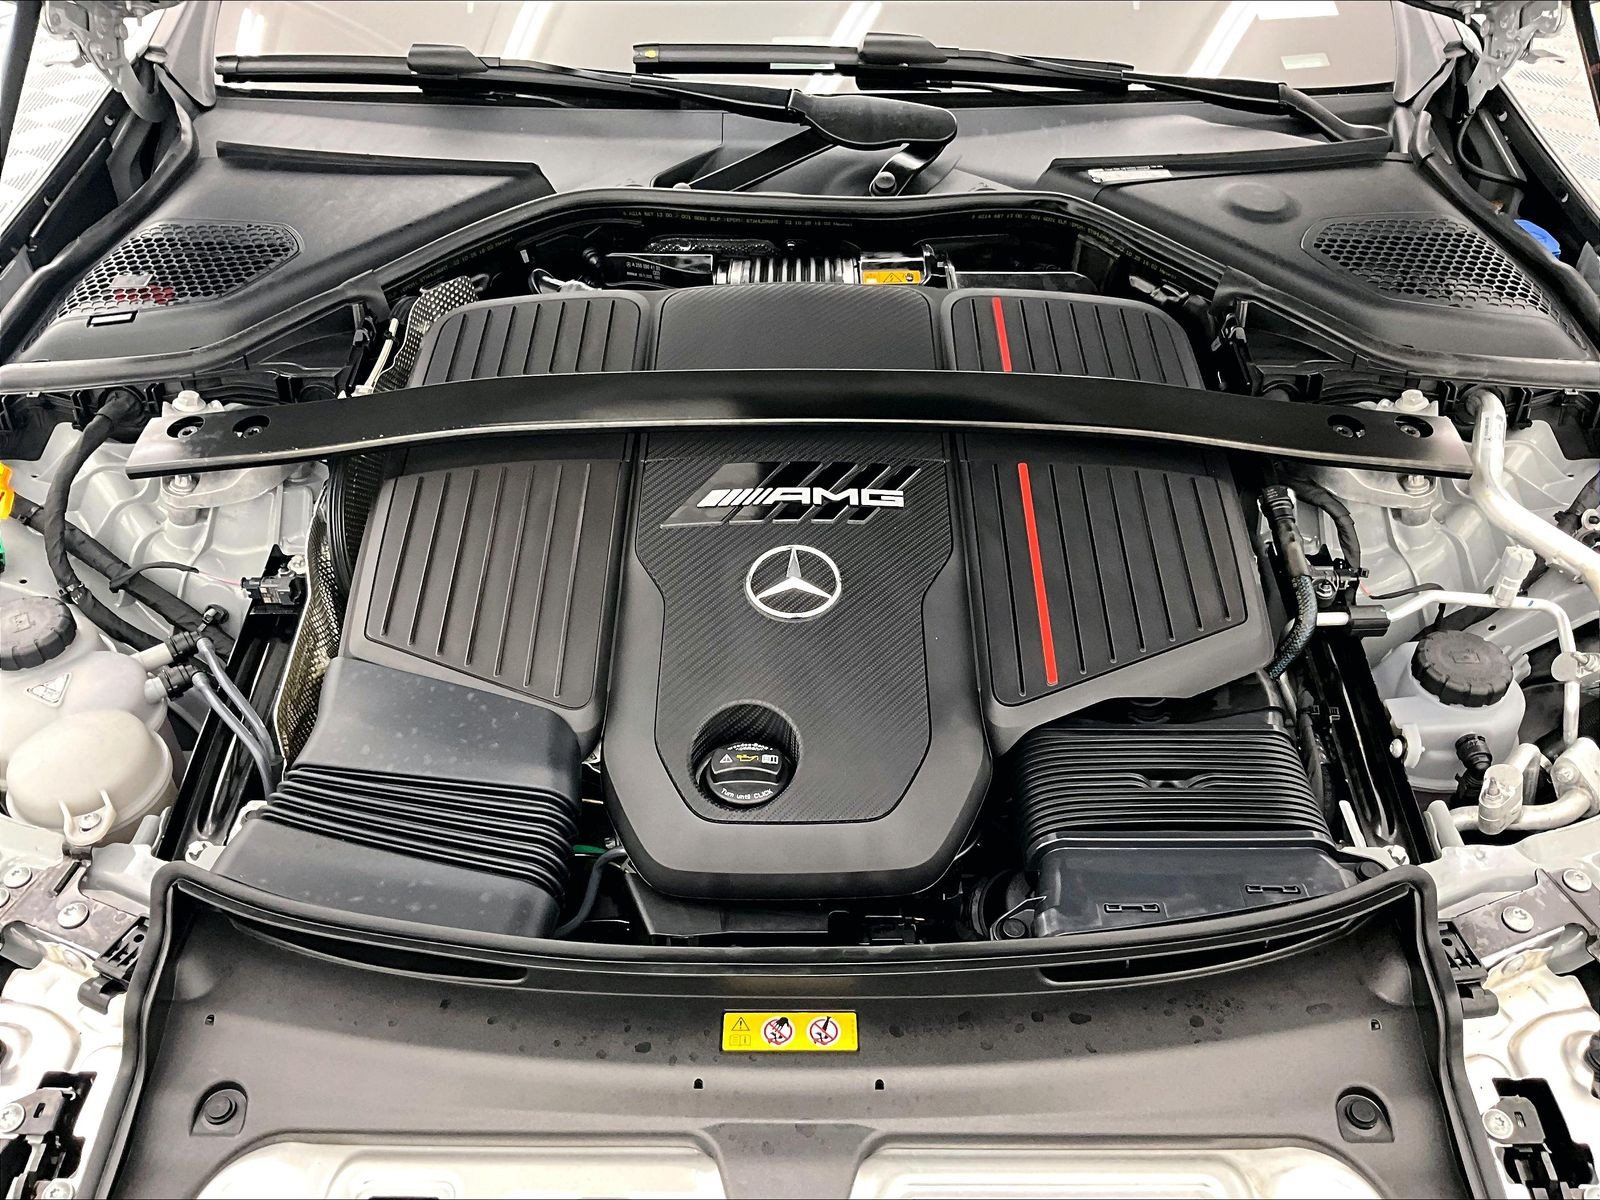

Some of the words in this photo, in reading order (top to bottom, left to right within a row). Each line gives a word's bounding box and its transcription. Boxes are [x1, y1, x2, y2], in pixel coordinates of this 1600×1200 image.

[763, 487, 904, 508] AMG
[721, 788, 734, 798] Turn
[754, 788, 773, 798] CLICK
